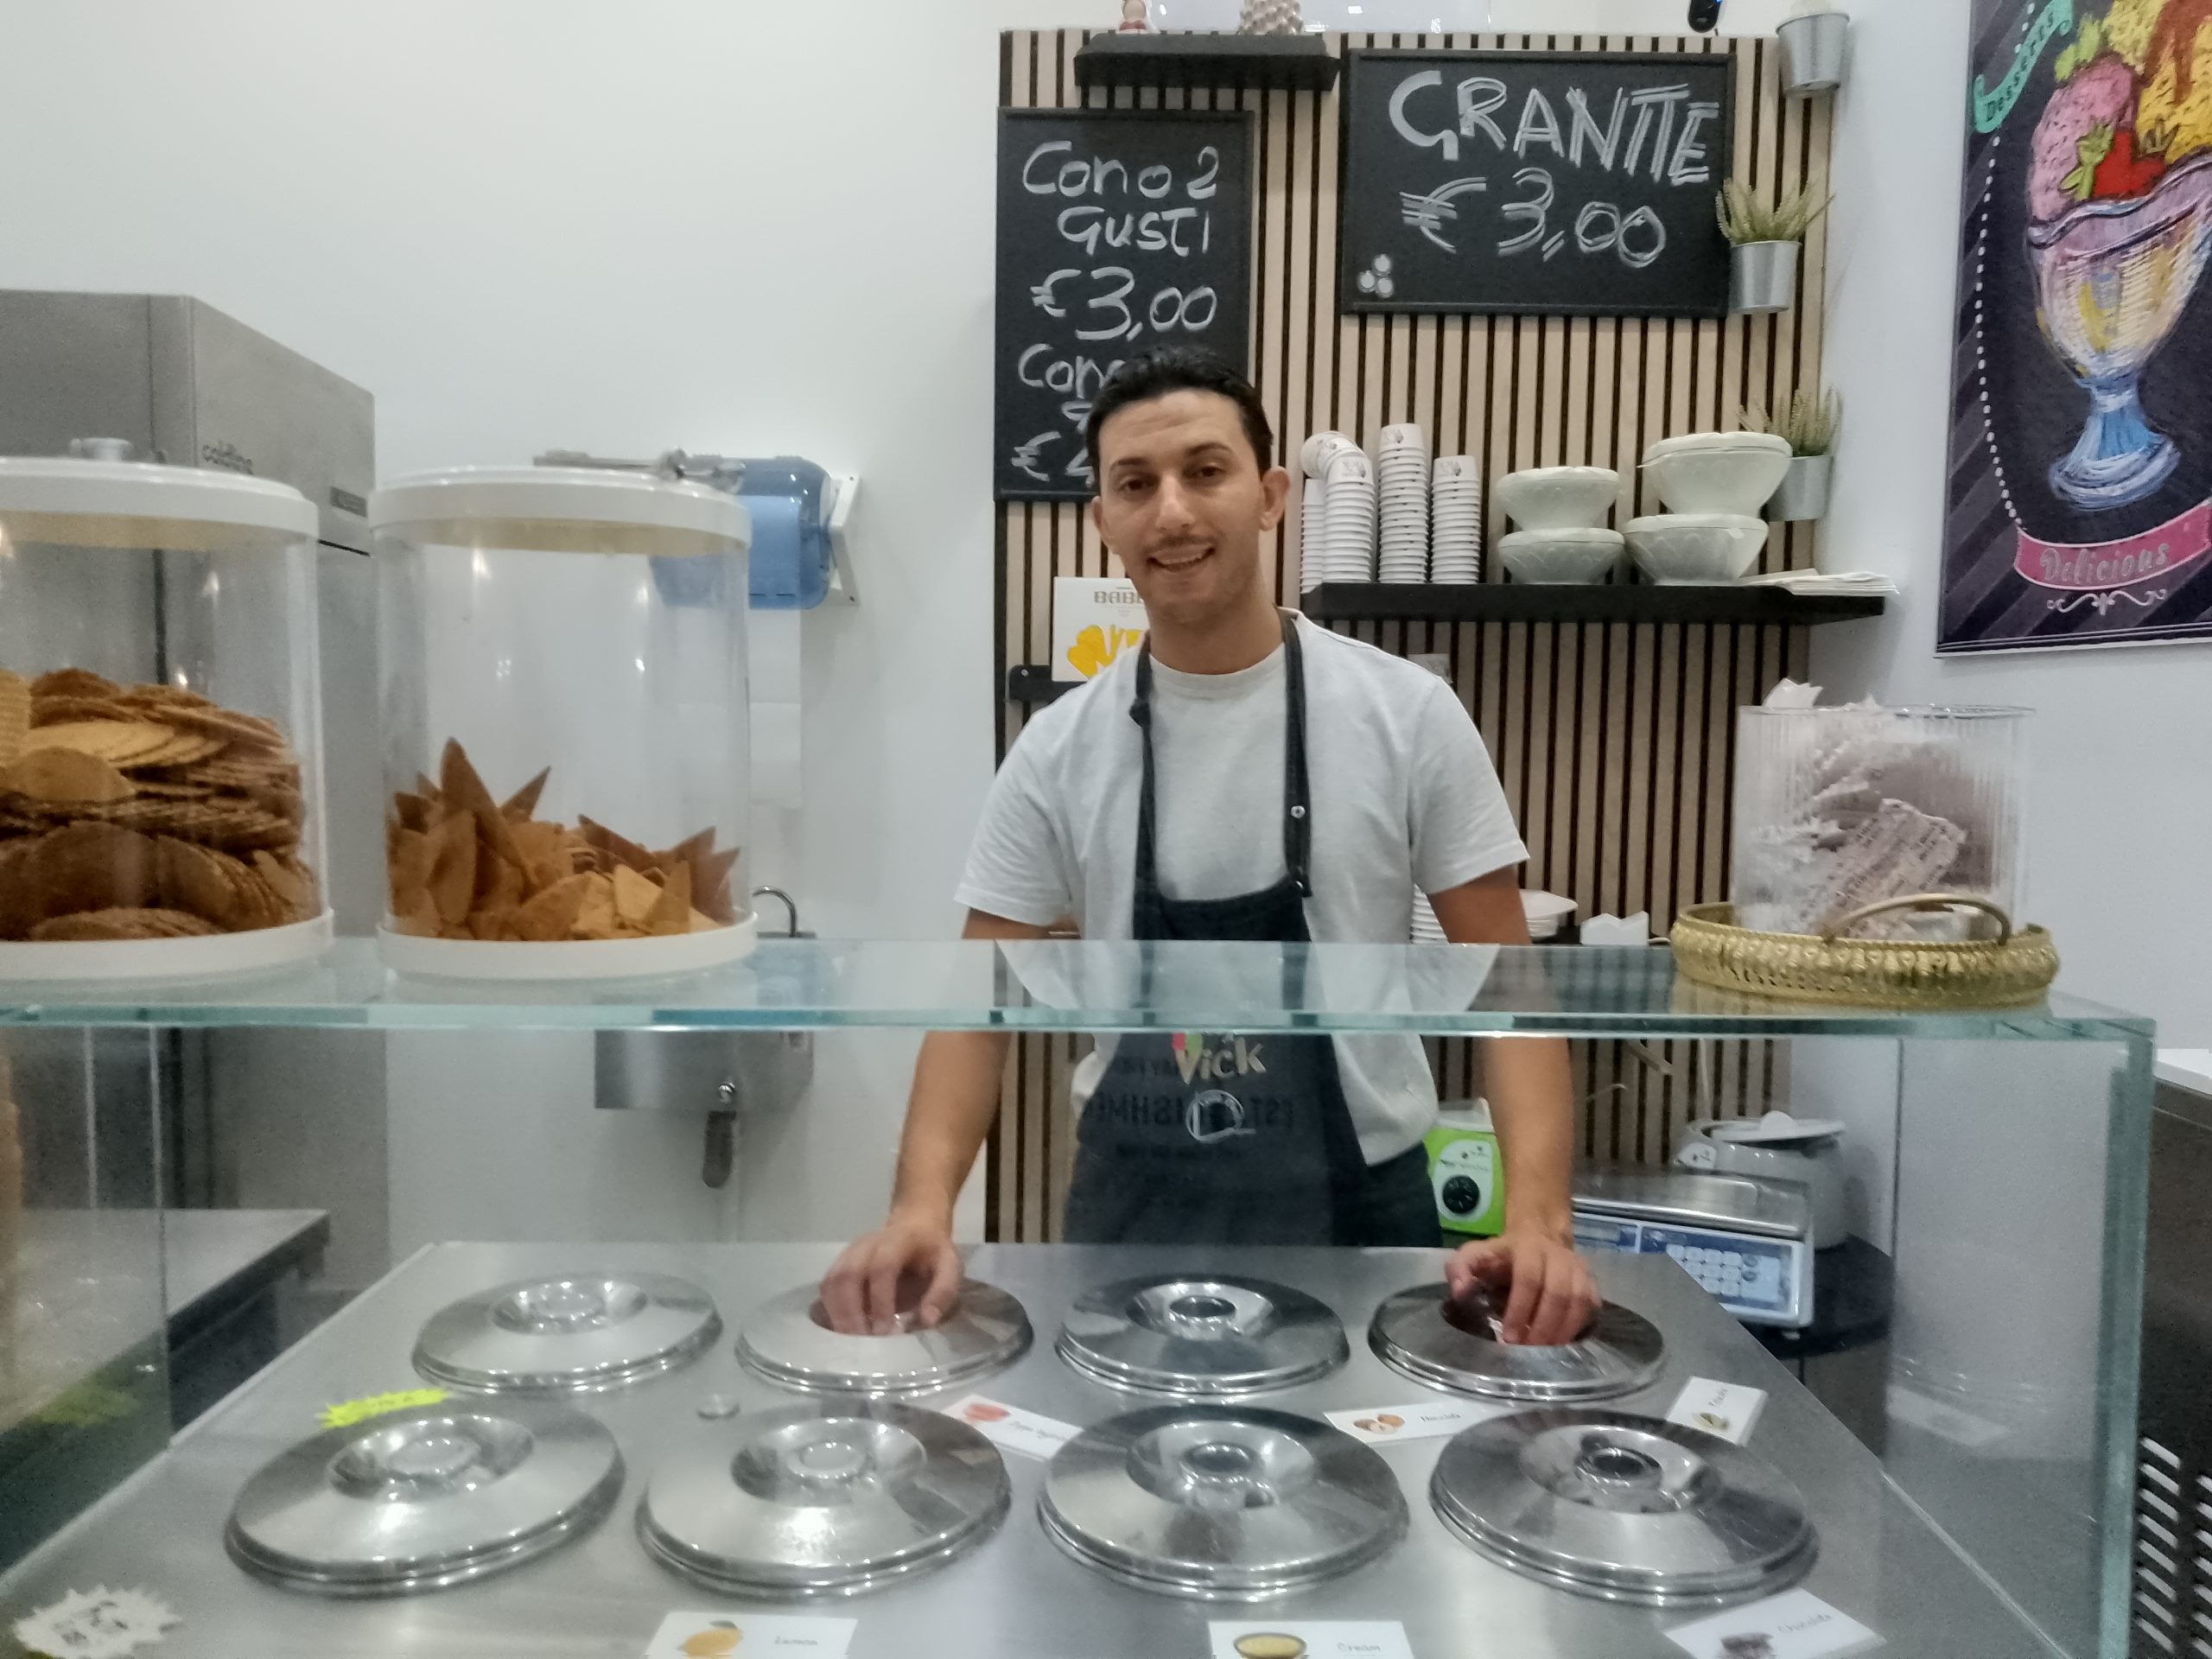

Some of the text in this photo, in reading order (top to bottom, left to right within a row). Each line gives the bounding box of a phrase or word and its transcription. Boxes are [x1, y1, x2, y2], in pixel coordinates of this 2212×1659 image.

[1389, 69, 1719, 187] GRANITE
[1022, 140, 1219, 200] Cono 2
[2039, 543, 2171, 585] Delicious
